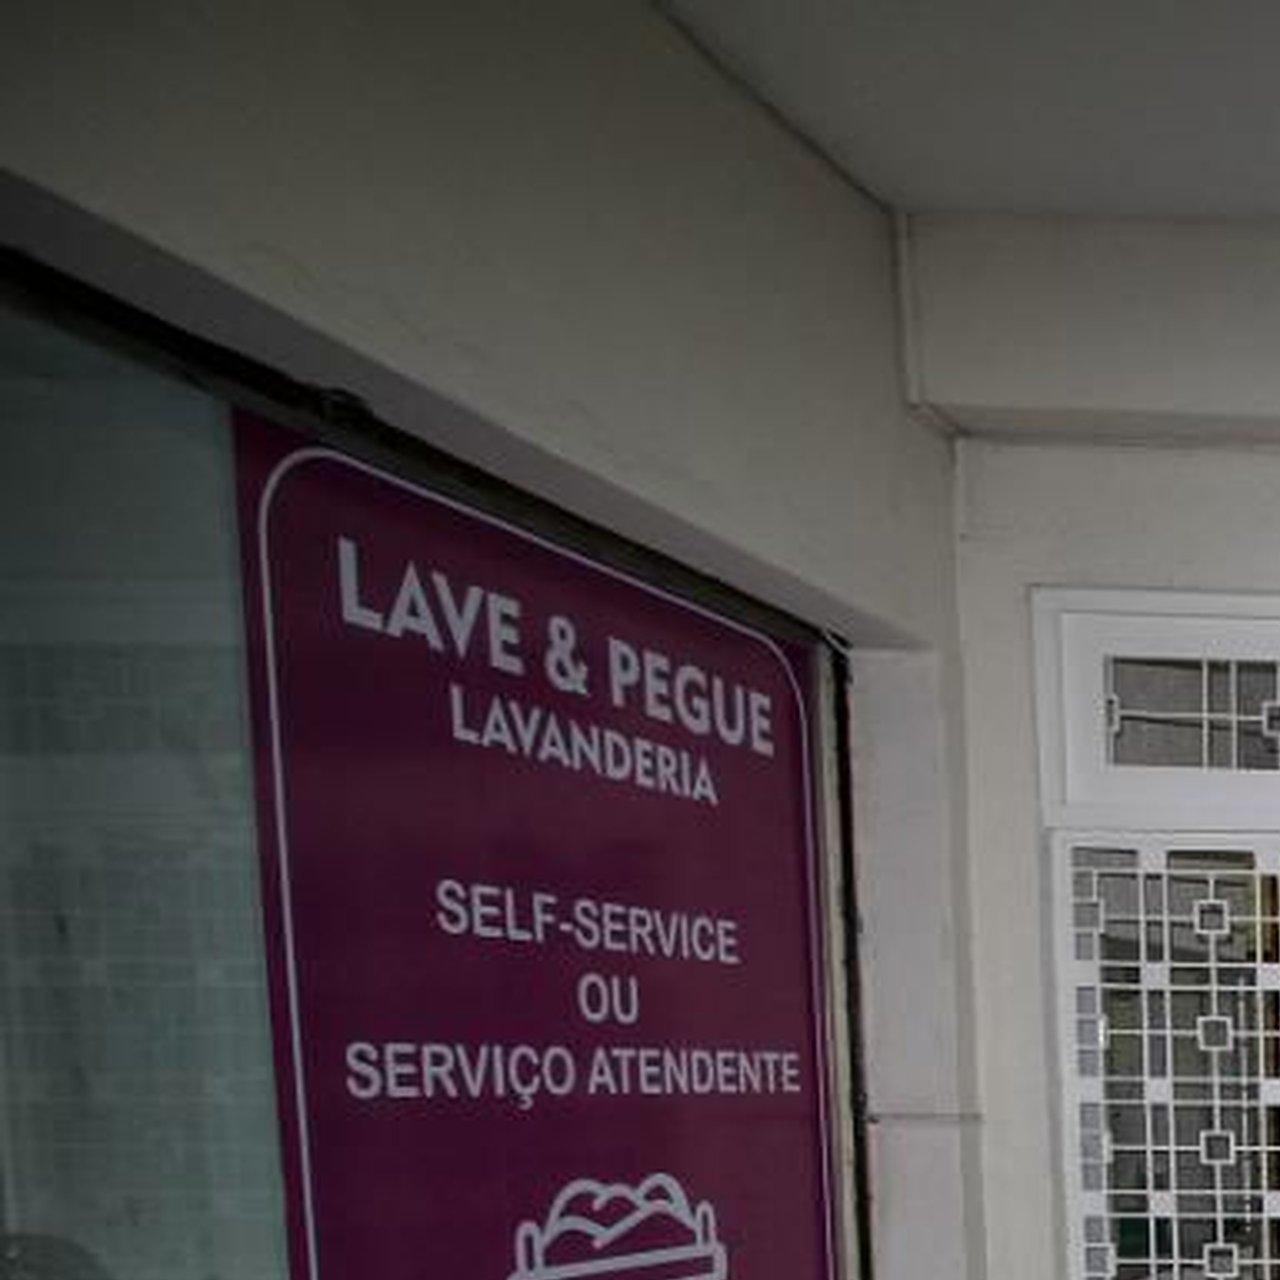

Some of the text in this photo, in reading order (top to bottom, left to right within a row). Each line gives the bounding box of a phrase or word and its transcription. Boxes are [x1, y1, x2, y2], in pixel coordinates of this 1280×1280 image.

[337, 535, 775, 759] LAVE & PEGUE
[448, 684, 719, 805] LAVANDERIA
[434, 877, 741, 965] SELF-SERVICE
[576, 972, 640, 1024] OU
[344, 1041, 803, 1111] SERVIÇO ATENDENTE
